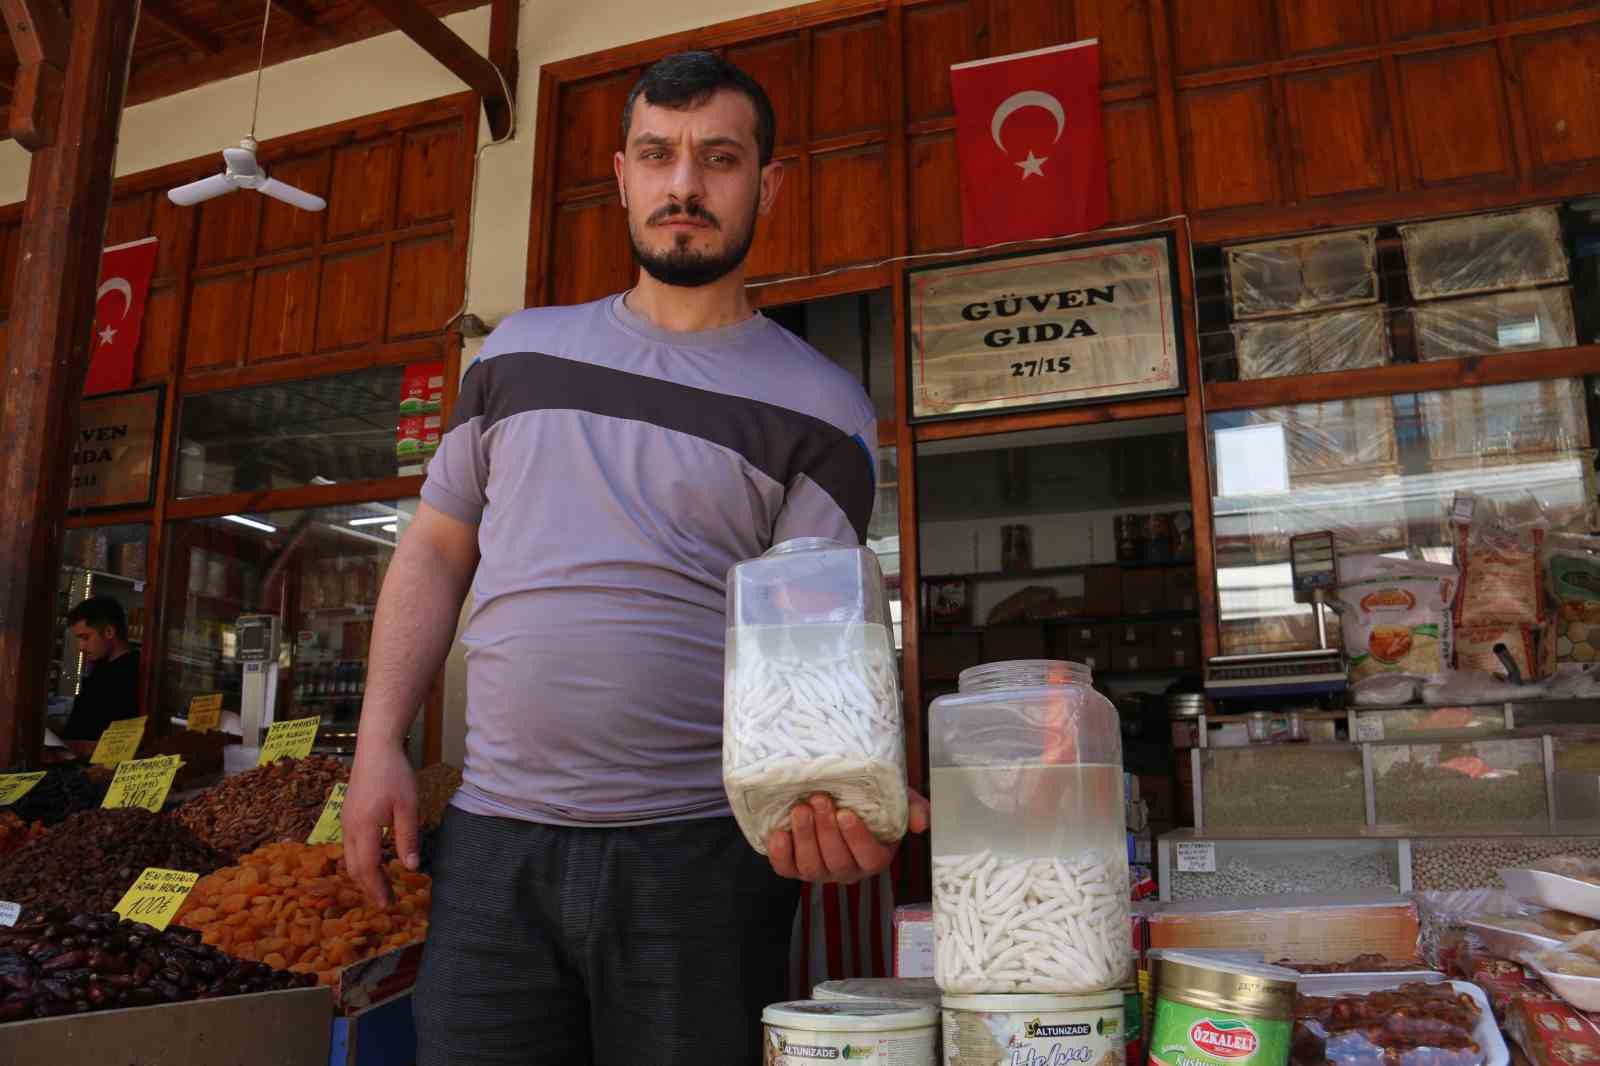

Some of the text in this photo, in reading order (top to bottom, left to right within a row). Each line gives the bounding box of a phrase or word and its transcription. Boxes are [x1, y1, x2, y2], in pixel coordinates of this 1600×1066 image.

[961, 284, 1118, 322] GÜVEN
[983, 319, 1098, 348] GIDA
[1010, 356, 1072, 377] 27/15
[80, 424, 128, 442] VEN
